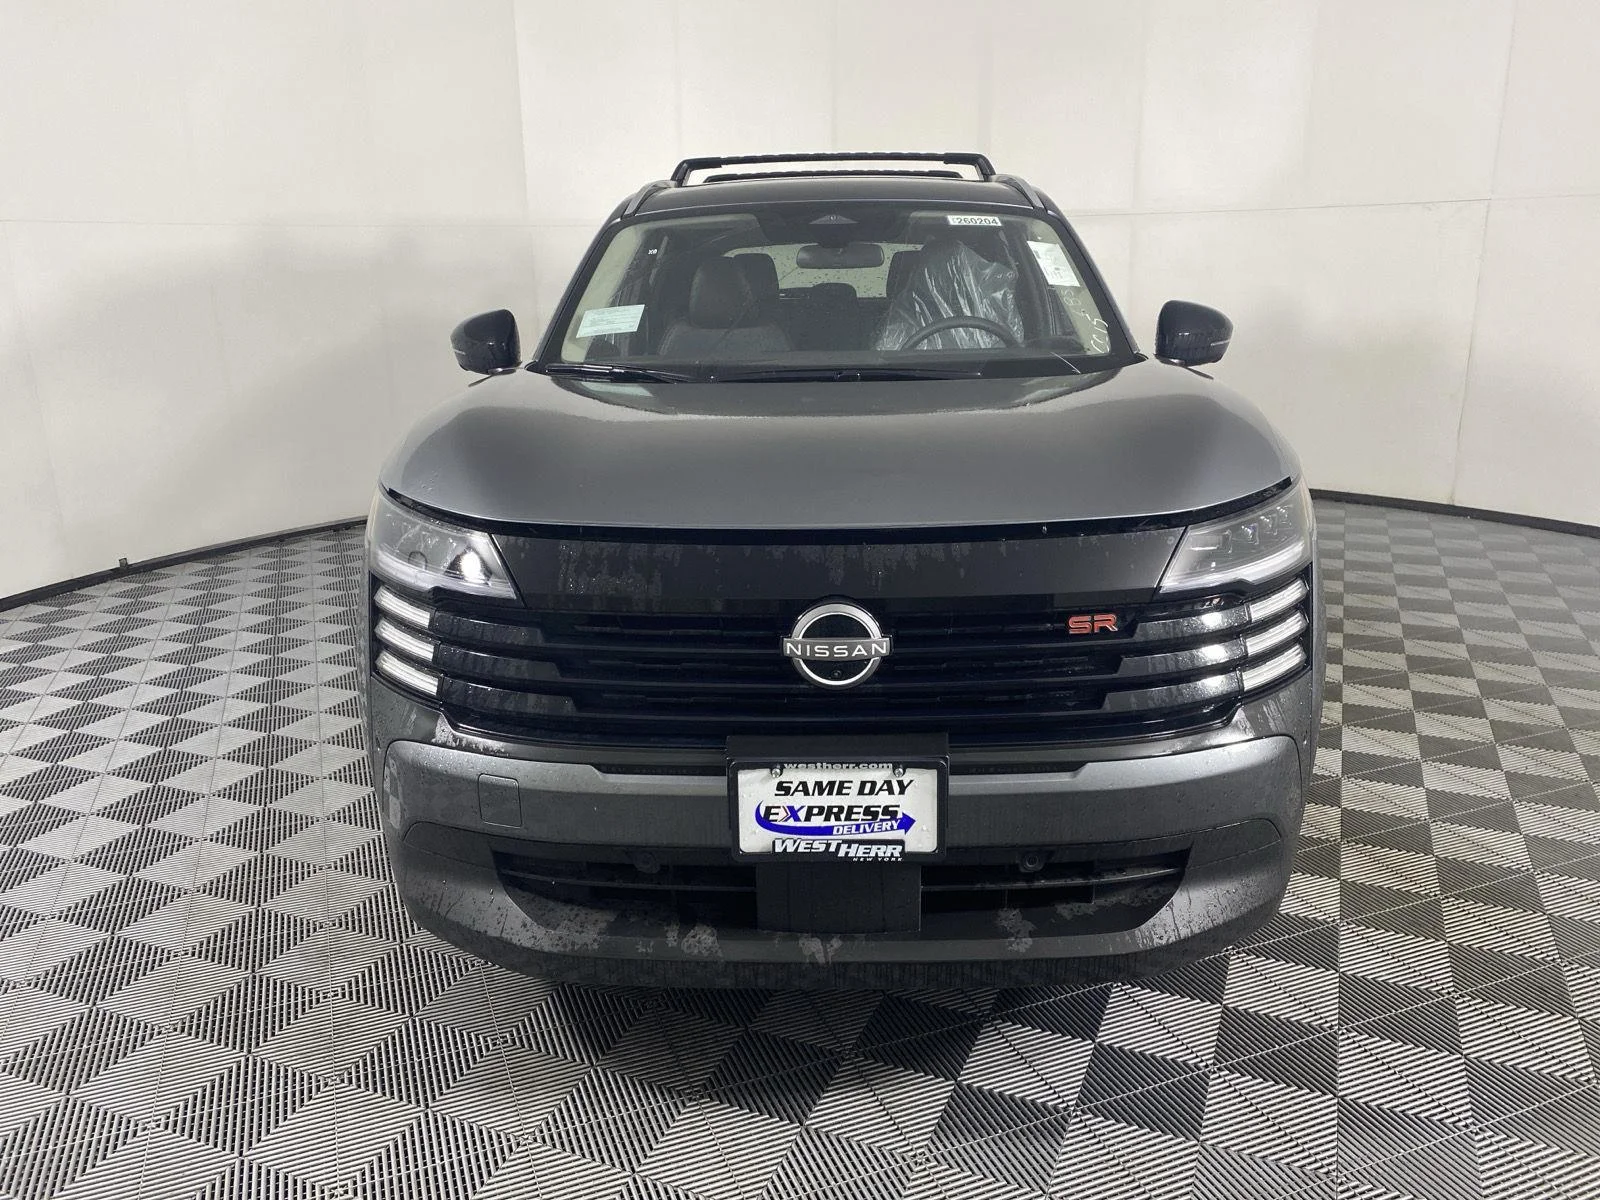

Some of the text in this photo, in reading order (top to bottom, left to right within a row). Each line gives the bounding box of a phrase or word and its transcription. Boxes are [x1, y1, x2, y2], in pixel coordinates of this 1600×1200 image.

[1068, 614, 1118, 634] SR
[785, 641, 887, 657] NISSAN
[783, 762, 893, 770] westherr.com
[775, 779, 914, 797] SAME DAY
[763, 804, 900, 822] EXPRESS
[832, 819, 901, 836] DELIVERY
[774, 838, 903, 858] WEST HERR
